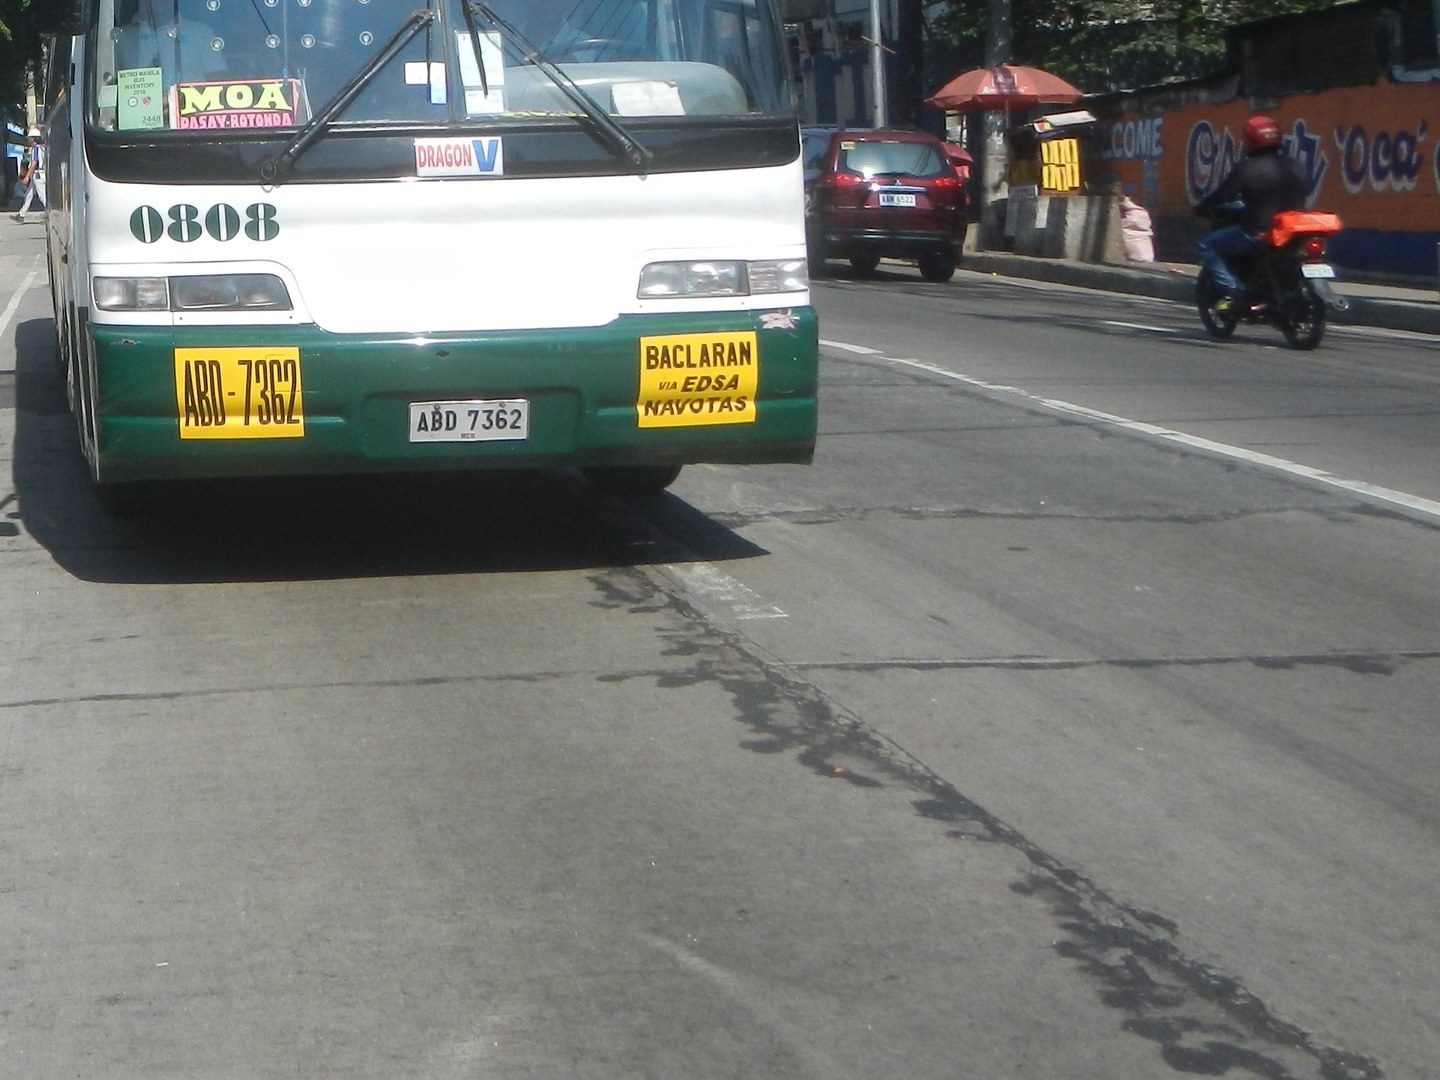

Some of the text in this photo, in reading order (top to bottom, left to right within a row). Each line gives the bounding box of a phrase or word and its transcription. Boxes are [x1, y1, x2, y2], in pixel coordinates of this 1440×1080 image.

[180, 83, 293, 115] MOA
[418, 139, 499, 172] DRAGON V
[130, 203, 280, 243] 0808
[646, 341, 751, 370] BACLARAN
[659, 374, 739, 393] VIA EDSA
[417, 408, 522, 431] ABD 7362
[644, 395, 748, 417] NAVOTAS
